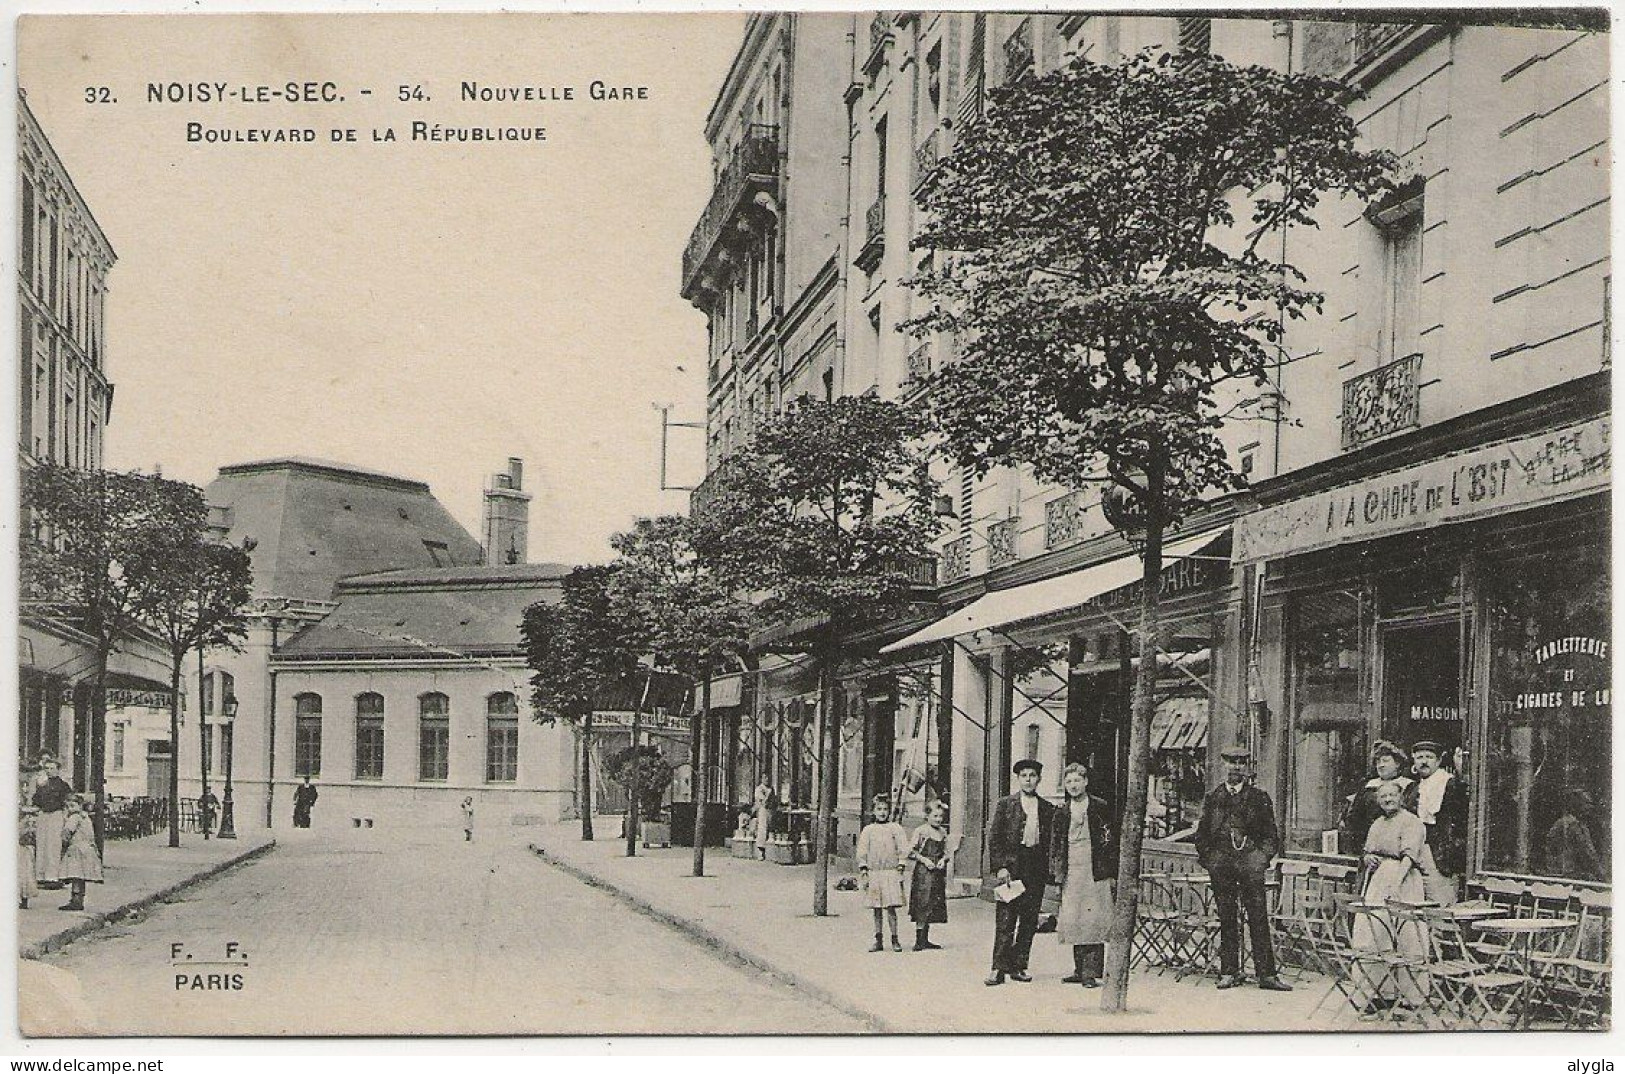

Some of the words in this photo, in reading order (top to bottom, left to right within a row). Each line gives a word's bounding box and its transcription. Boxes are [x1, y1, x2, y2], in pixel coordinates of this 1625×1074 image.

[1535, 637, 1608, 664] TABLETTERIE
[1563, 668, 1575, 682] ET
[1517, 691, 1563, 709] CIGARES
[1572, 691, 1586, 707] DE
[1410, 706, 1459, 720] MAISON
